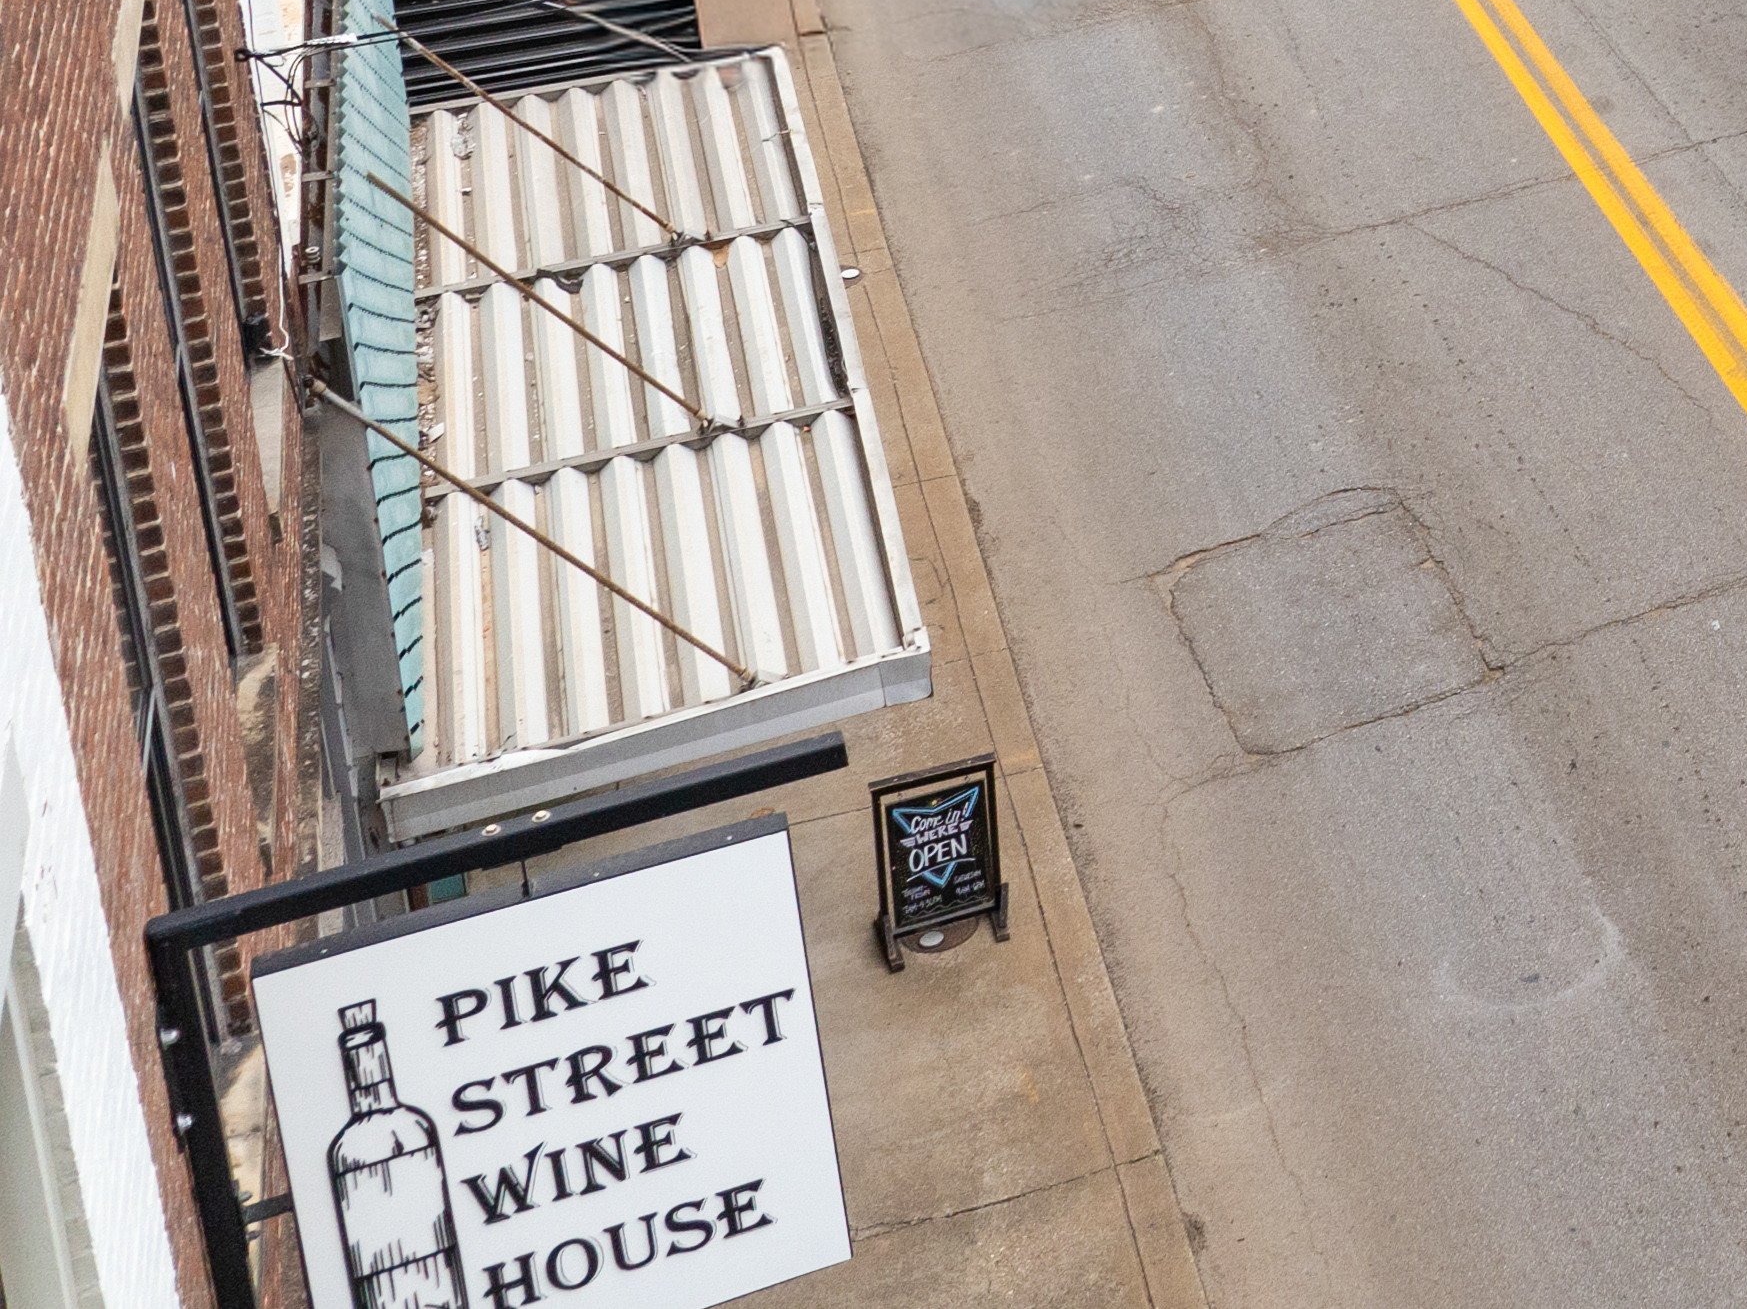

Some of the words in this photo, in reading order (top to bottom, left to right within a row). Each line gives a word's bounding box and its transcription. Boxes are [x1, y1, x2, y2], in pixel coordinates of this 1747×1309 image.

[909, 833, 968, 873] OPEN
[910, 815, 944, 834] Come
[434, 939, 657, 1048] PIKE
[451, 987, 797, 1137] STREET
[460, 1112, 698, 1226] WINE
[481, 1178, 778, 1309] HOUSE
